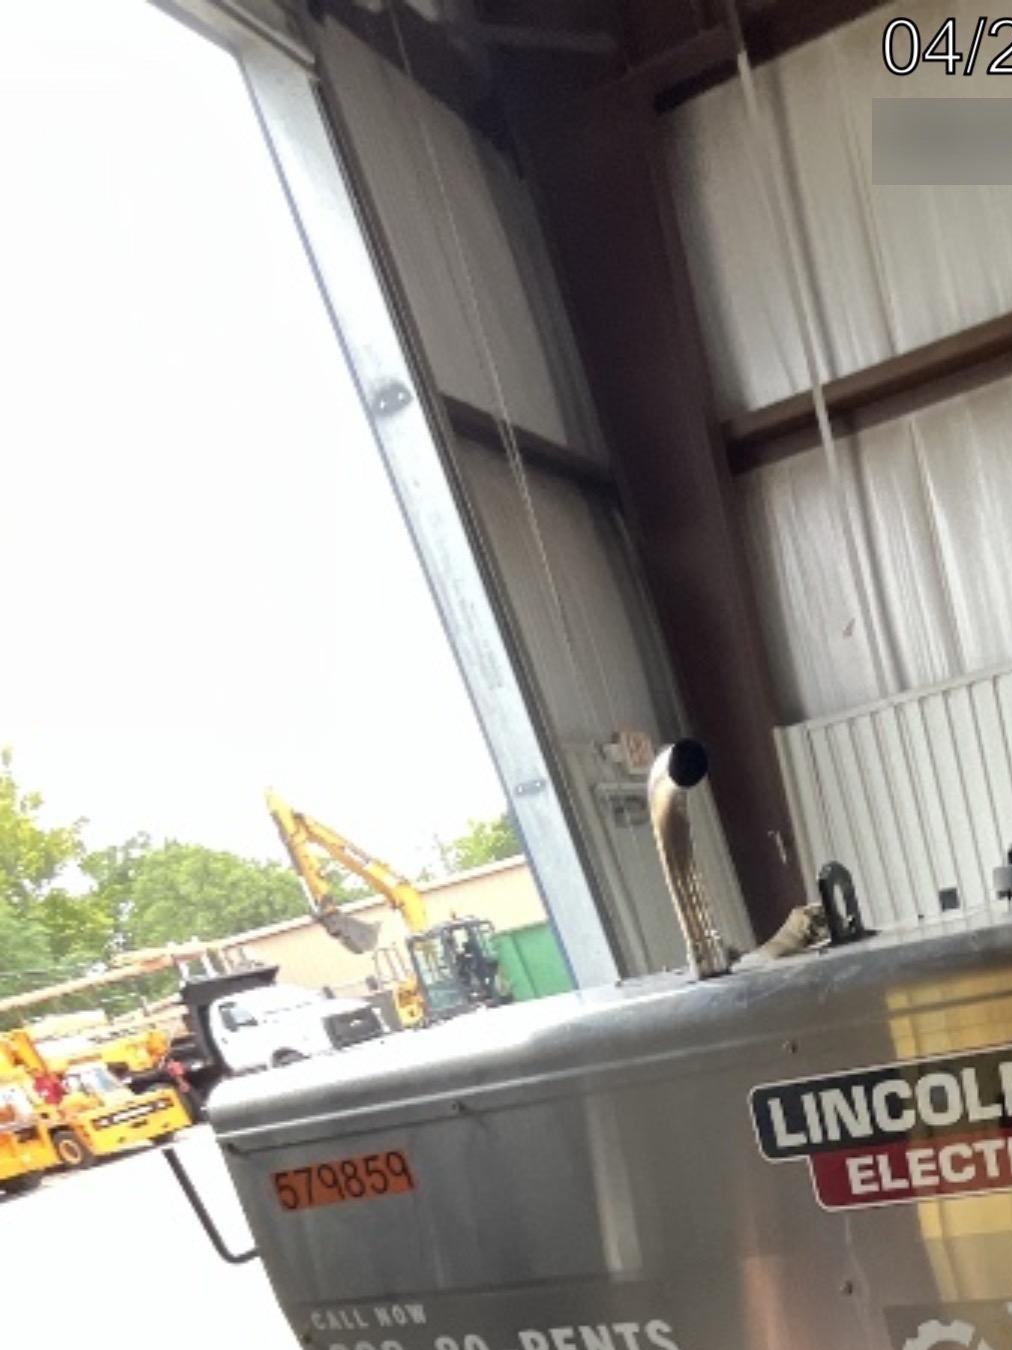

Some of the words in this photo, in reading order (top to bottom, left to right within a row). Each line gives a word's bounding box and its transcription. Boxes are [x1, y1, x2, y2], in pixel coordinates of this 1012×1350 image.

[273, 1150, 414, 1210] 579859
[310, 1308, 370, 1332] CALL
[375, 1303, 428, 1328] NOW
